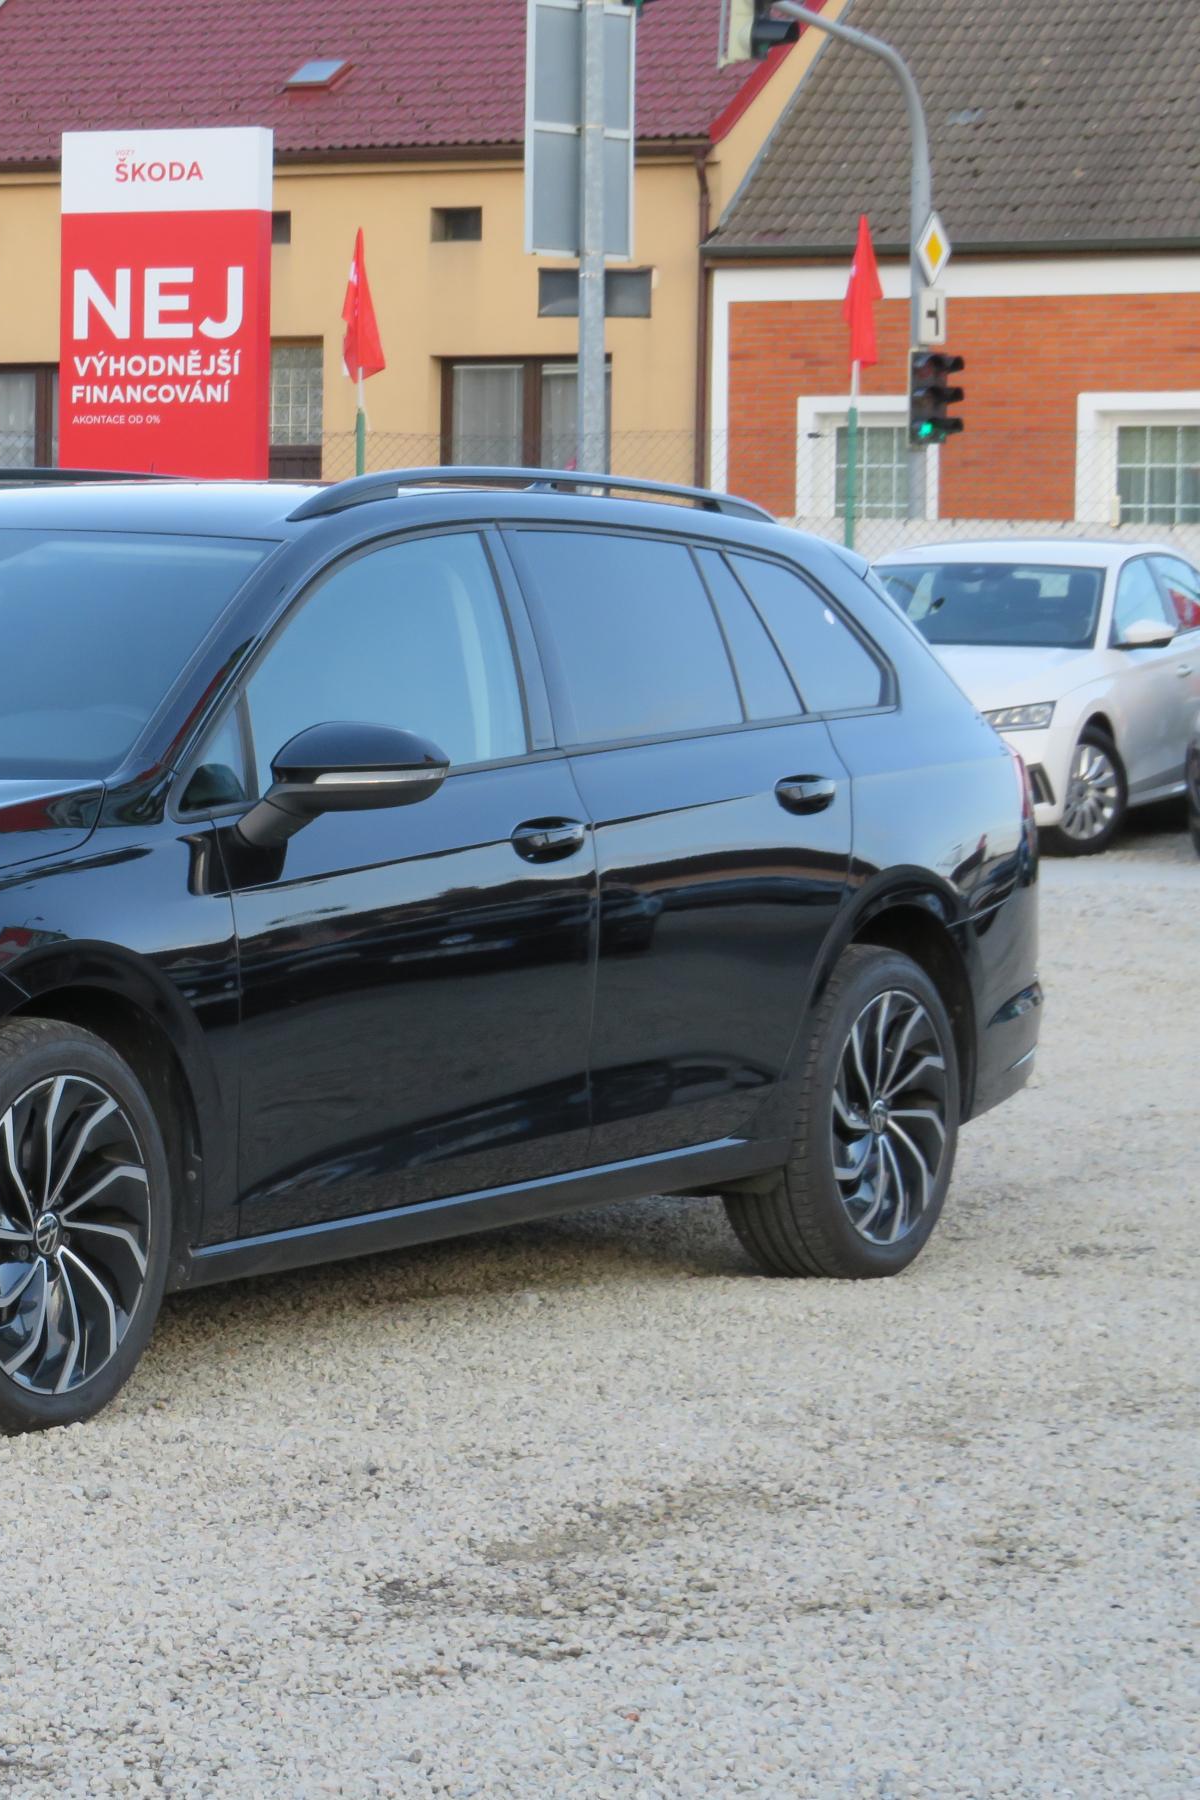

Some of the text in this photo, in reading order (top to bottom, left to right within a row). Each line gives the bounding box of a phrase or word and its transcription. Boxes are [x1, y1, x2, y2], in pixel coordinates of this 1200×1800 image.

[115, 157, 204, 183] ŠKODA
[73, 266, 244, 340] NEJ
[73, 349, 242, 377] VÝHODNĚJŠÍ
[71, 380, 231, 404] FINANCOVÁNÍ
[72, 414, 161, 424] AKONTACE OD 0%
